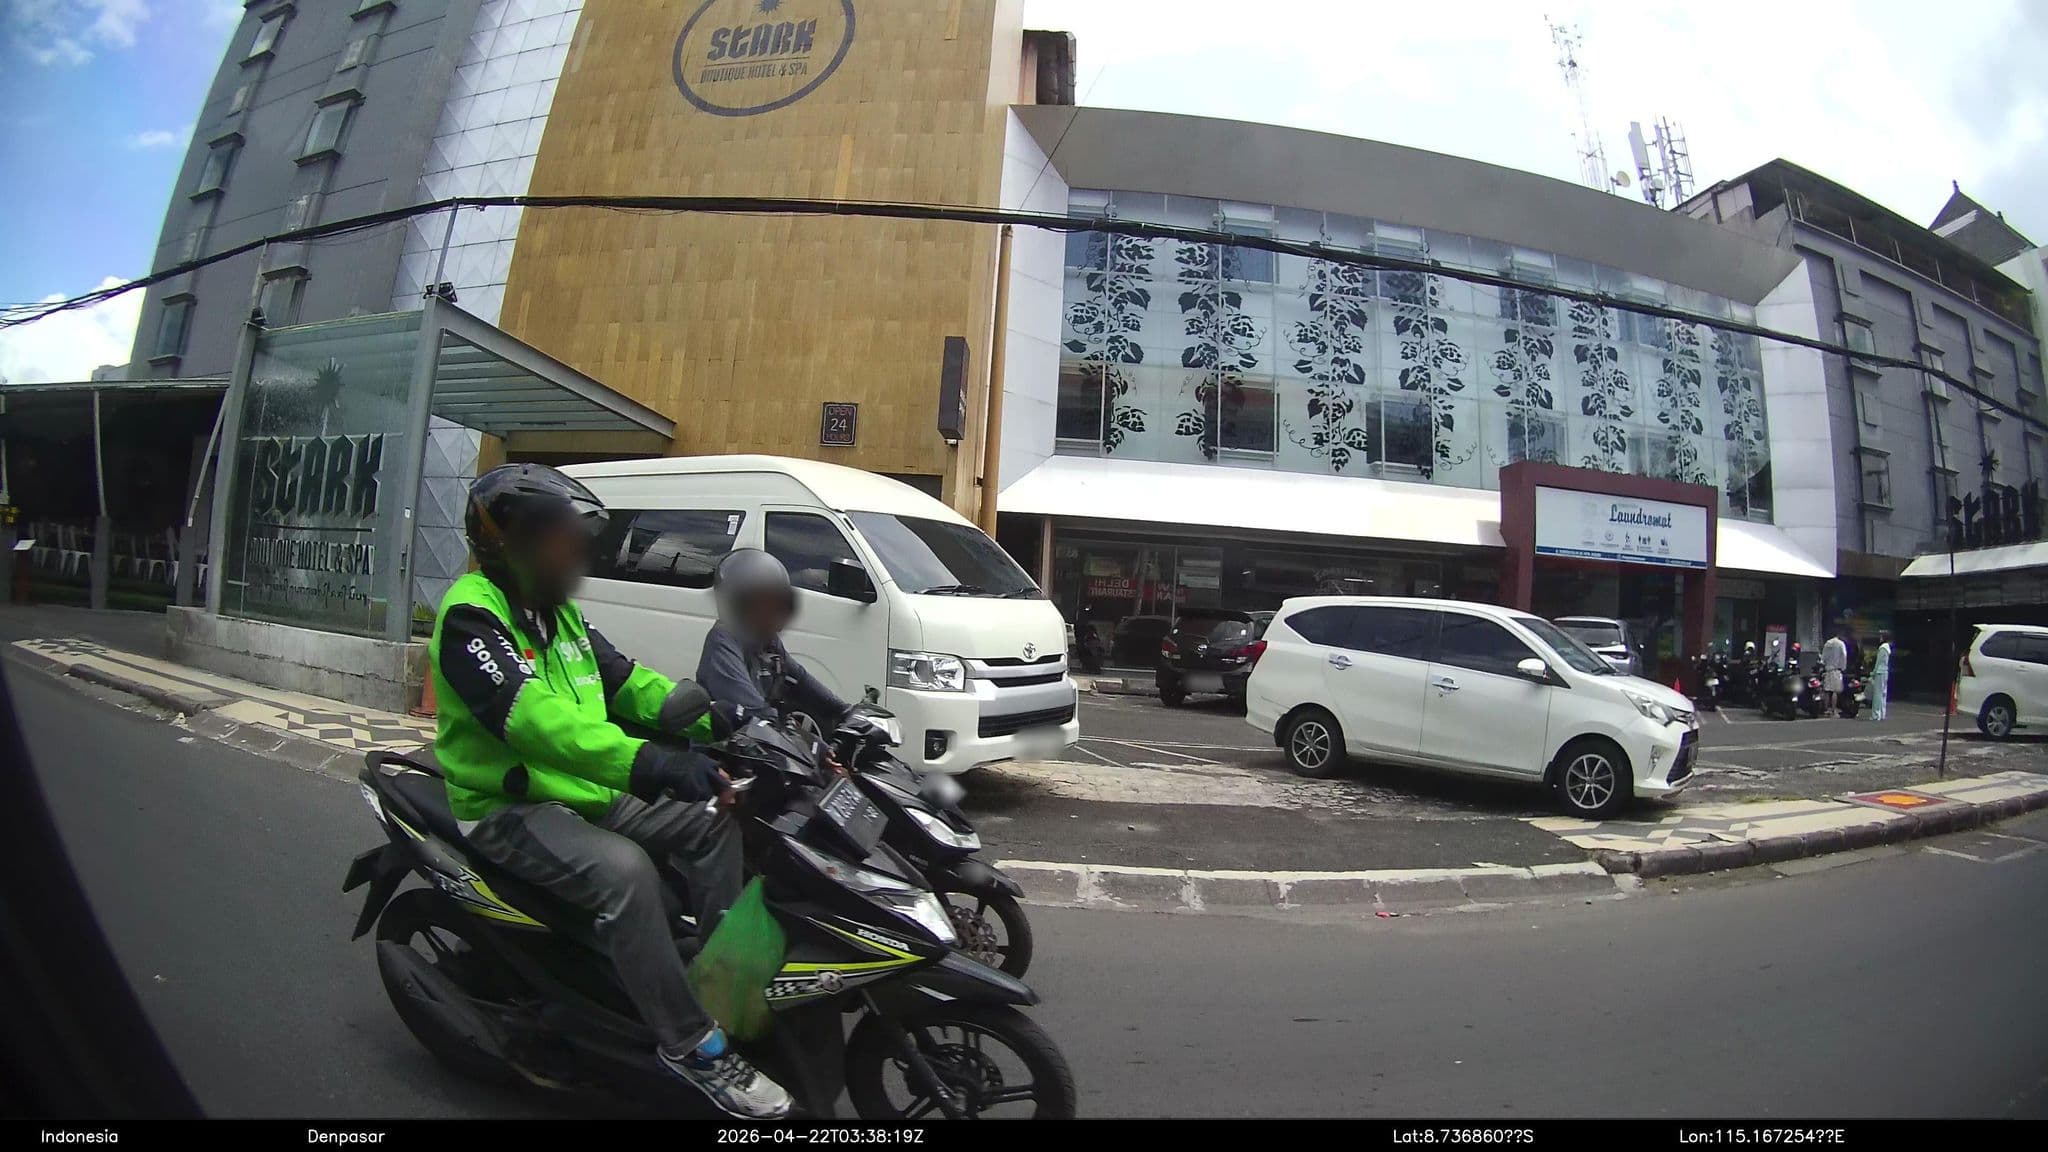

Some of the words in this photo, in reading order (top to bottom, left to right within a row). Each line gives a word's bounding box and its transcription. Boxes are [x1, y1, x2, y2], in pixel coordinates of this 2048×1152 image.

[700, 68, 746, 83] BOUTIQUE
[748, 66, 776, 79] HOTEL
[779, 67, 788, 77] &
[789, 63, 808, 76] SPA
[828, 407, 852, 416] OPEN
[830, 418, 848, 432] 24
[1609, 504, 1672, 528] Laundromat
[297, 540, 332, 572] HOTEL
[334, 543, 345, 573] &
[346, 543, 371, 576] SPA
[855, 927, 912, 952] HONDA
